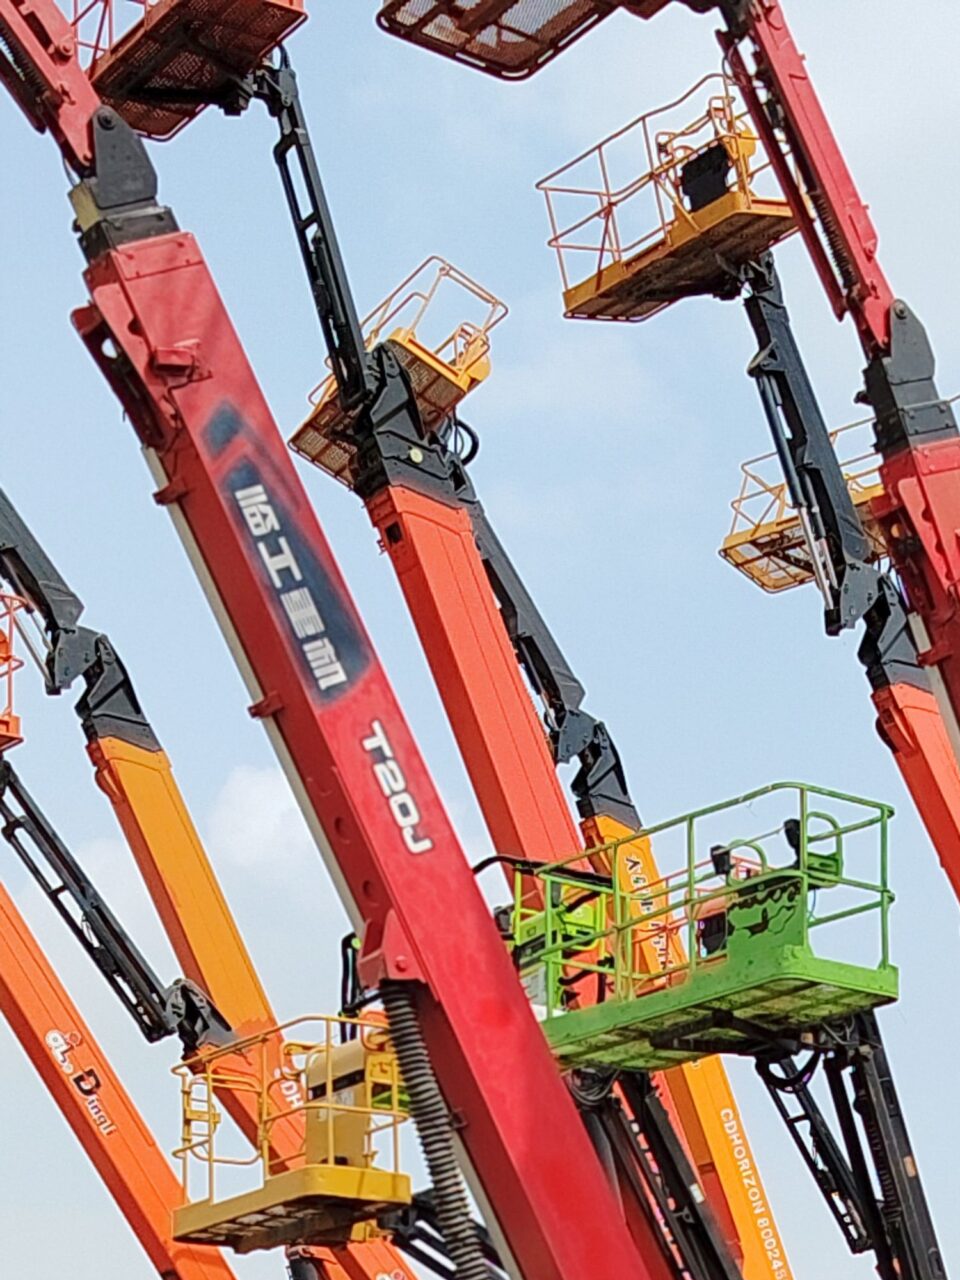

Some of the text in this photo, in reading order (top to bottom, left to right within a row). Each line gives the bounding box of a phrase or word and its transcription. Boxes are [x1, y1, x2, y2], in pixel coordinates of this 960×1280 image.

[234, 484, 347, 690] 临工重机
[361, 719, 433, 854] T20J
[720, 1108, 766, 1214] CDHORIZON
